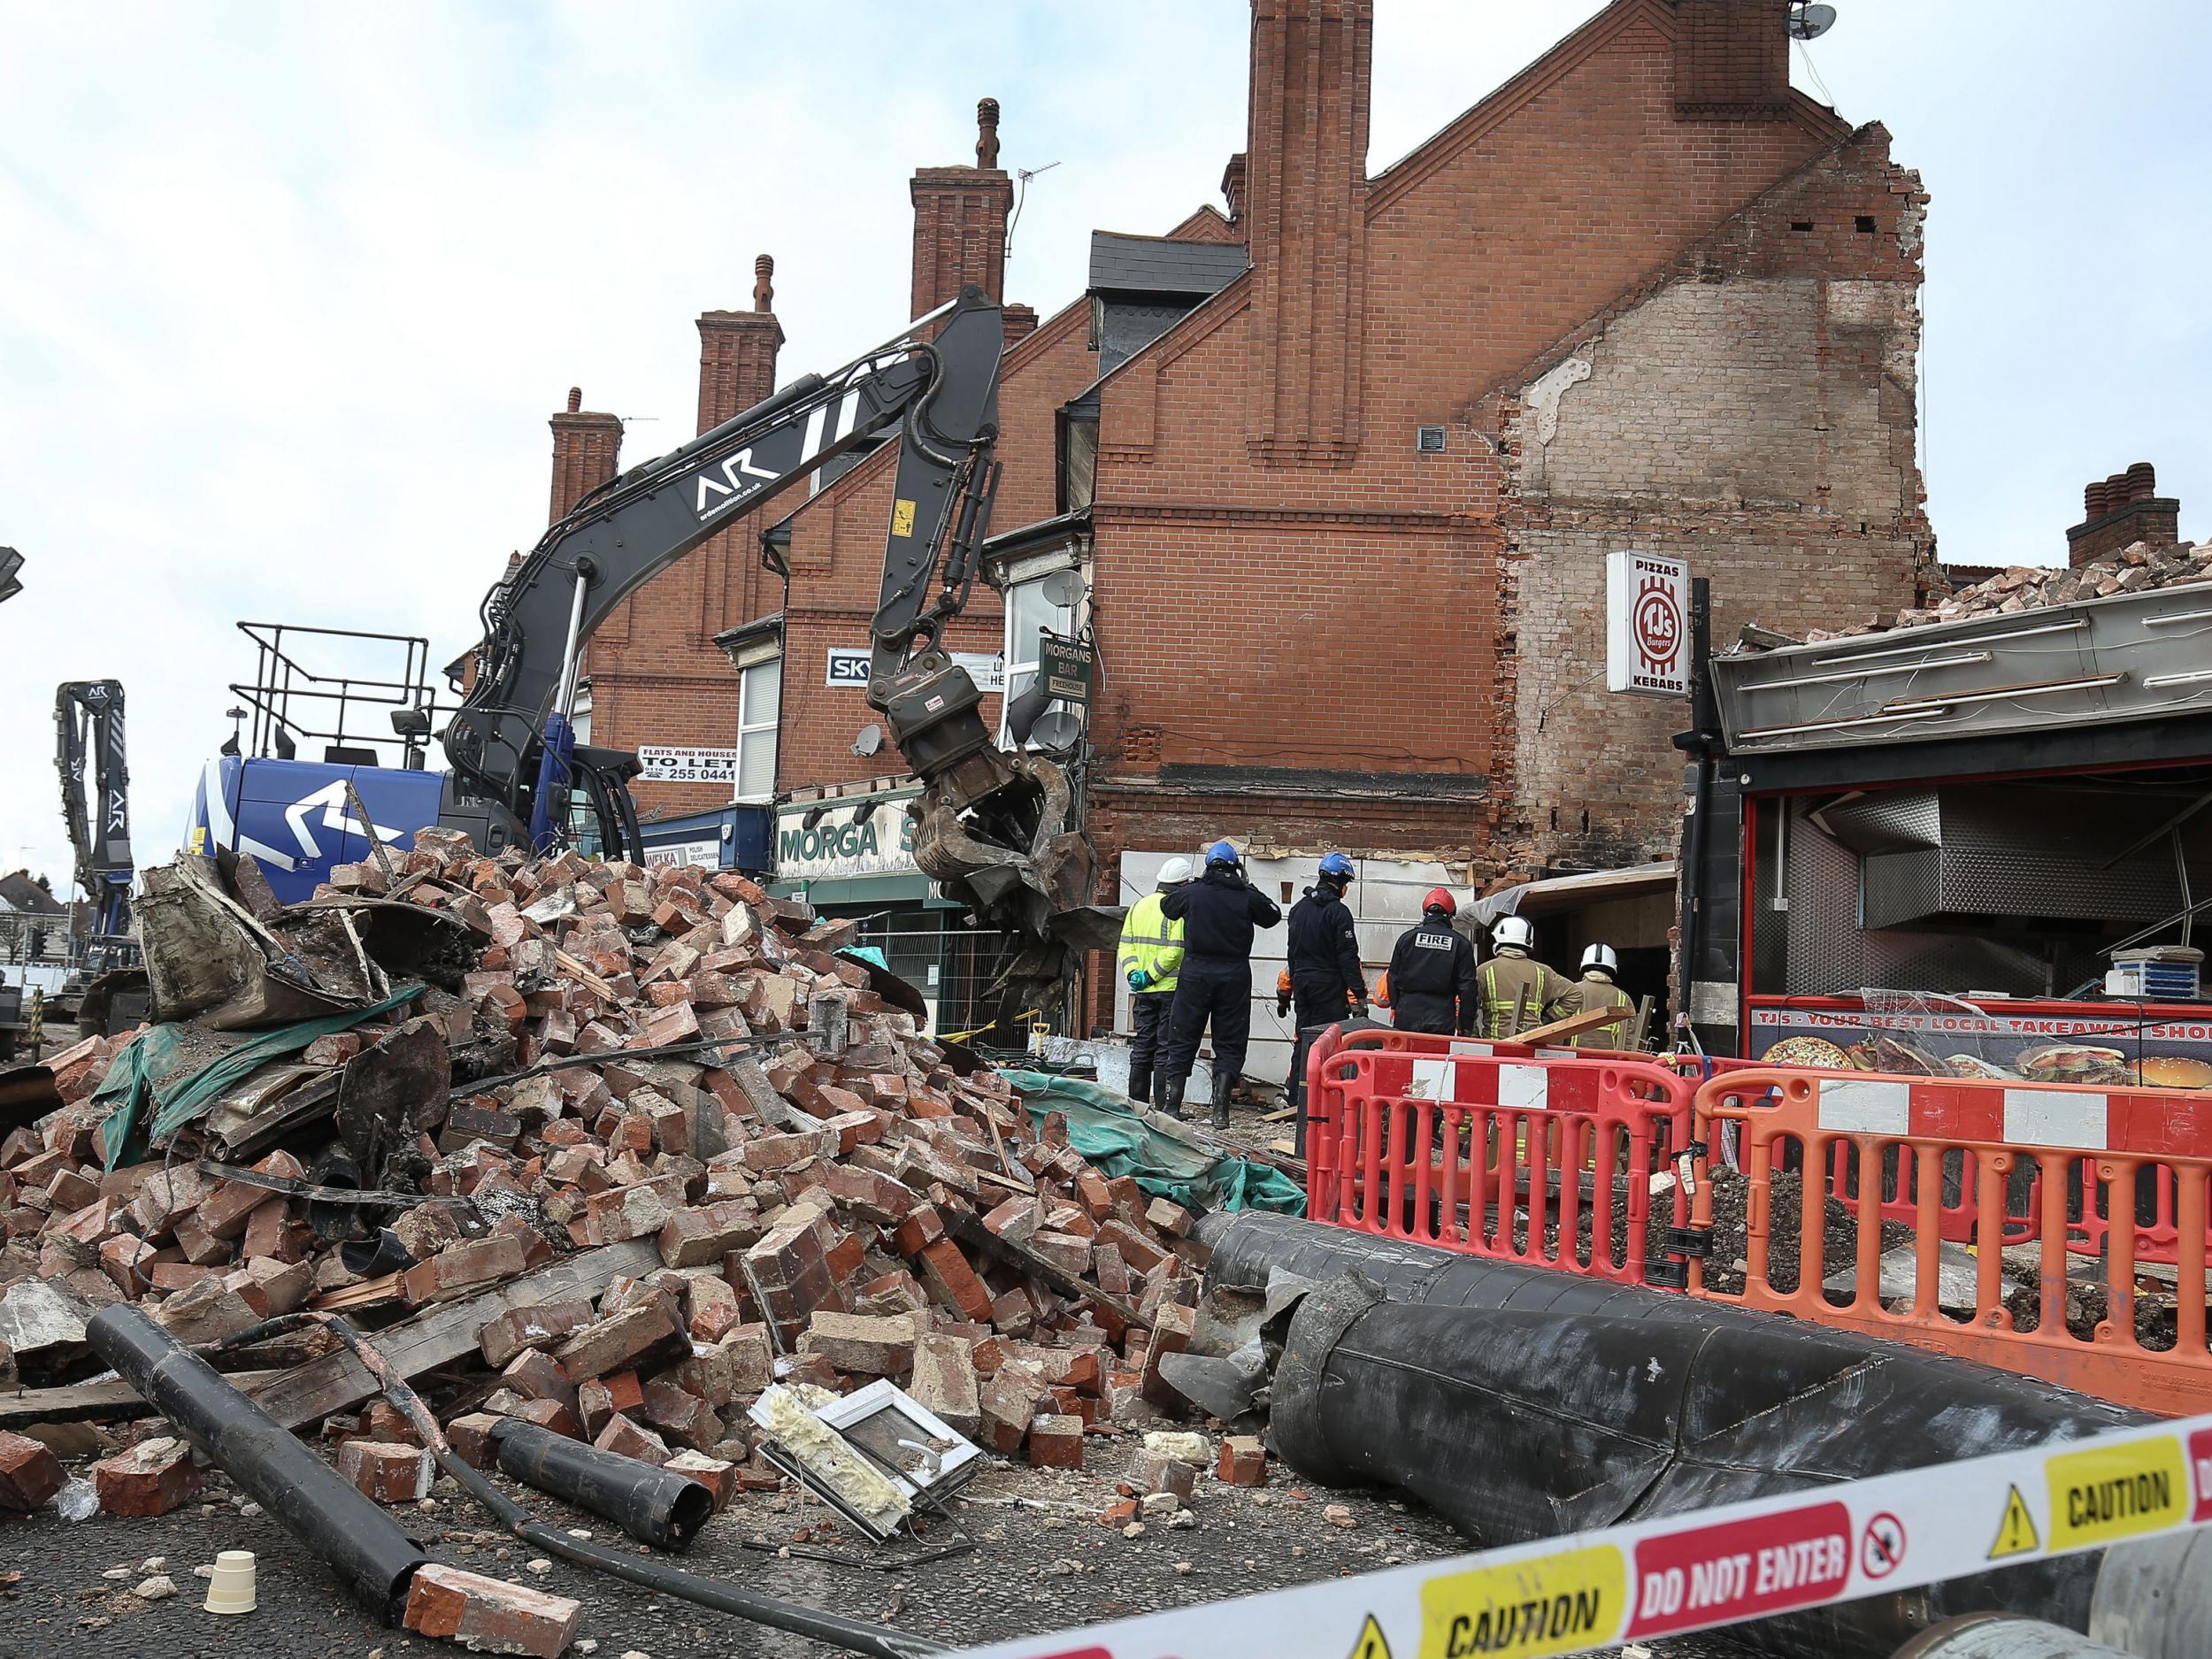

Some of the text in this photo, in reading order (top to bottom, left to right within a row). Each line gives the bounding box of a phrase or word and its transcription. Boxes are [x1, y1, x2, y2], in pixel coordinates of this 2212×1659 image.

[696, 447, 781, 512] AR
[1635, 560, 1679, 578] PIZZAS
[1647, 636, 1671, 650] Burgers
[1045, 642, 1091, 664] MORGANS
[1058, 662, 1078, 676] BAR
[1052, 679, 1084, 691] FREEHOUSE
[1633, 675, 1683, 691] KEBABS
[88, 686, 109, 699] AR
[642, 757, 736, 769] TO LET
[669, 768, 736, 780] 255 0441
[107, 788, 126, 833] AR
[1419, 933, 1449, 946] FIRE
[1806, 1014, 1862, 1027] YOUR
[1871, 1017, 1924, 1030] BEST
[1932, 1018, 2001, 1032] LOCAL
[2008, 1020, 2141, 1037] TAKEAWAY
[2151, 1025, 2212, 1040] SHO
[2068, 1470, 2171, 1529] CAUTION
[1640, 1534, 1847, 1619] DO NOT ENTER
[1445, 1588, 1601, 1659] CAUTION
